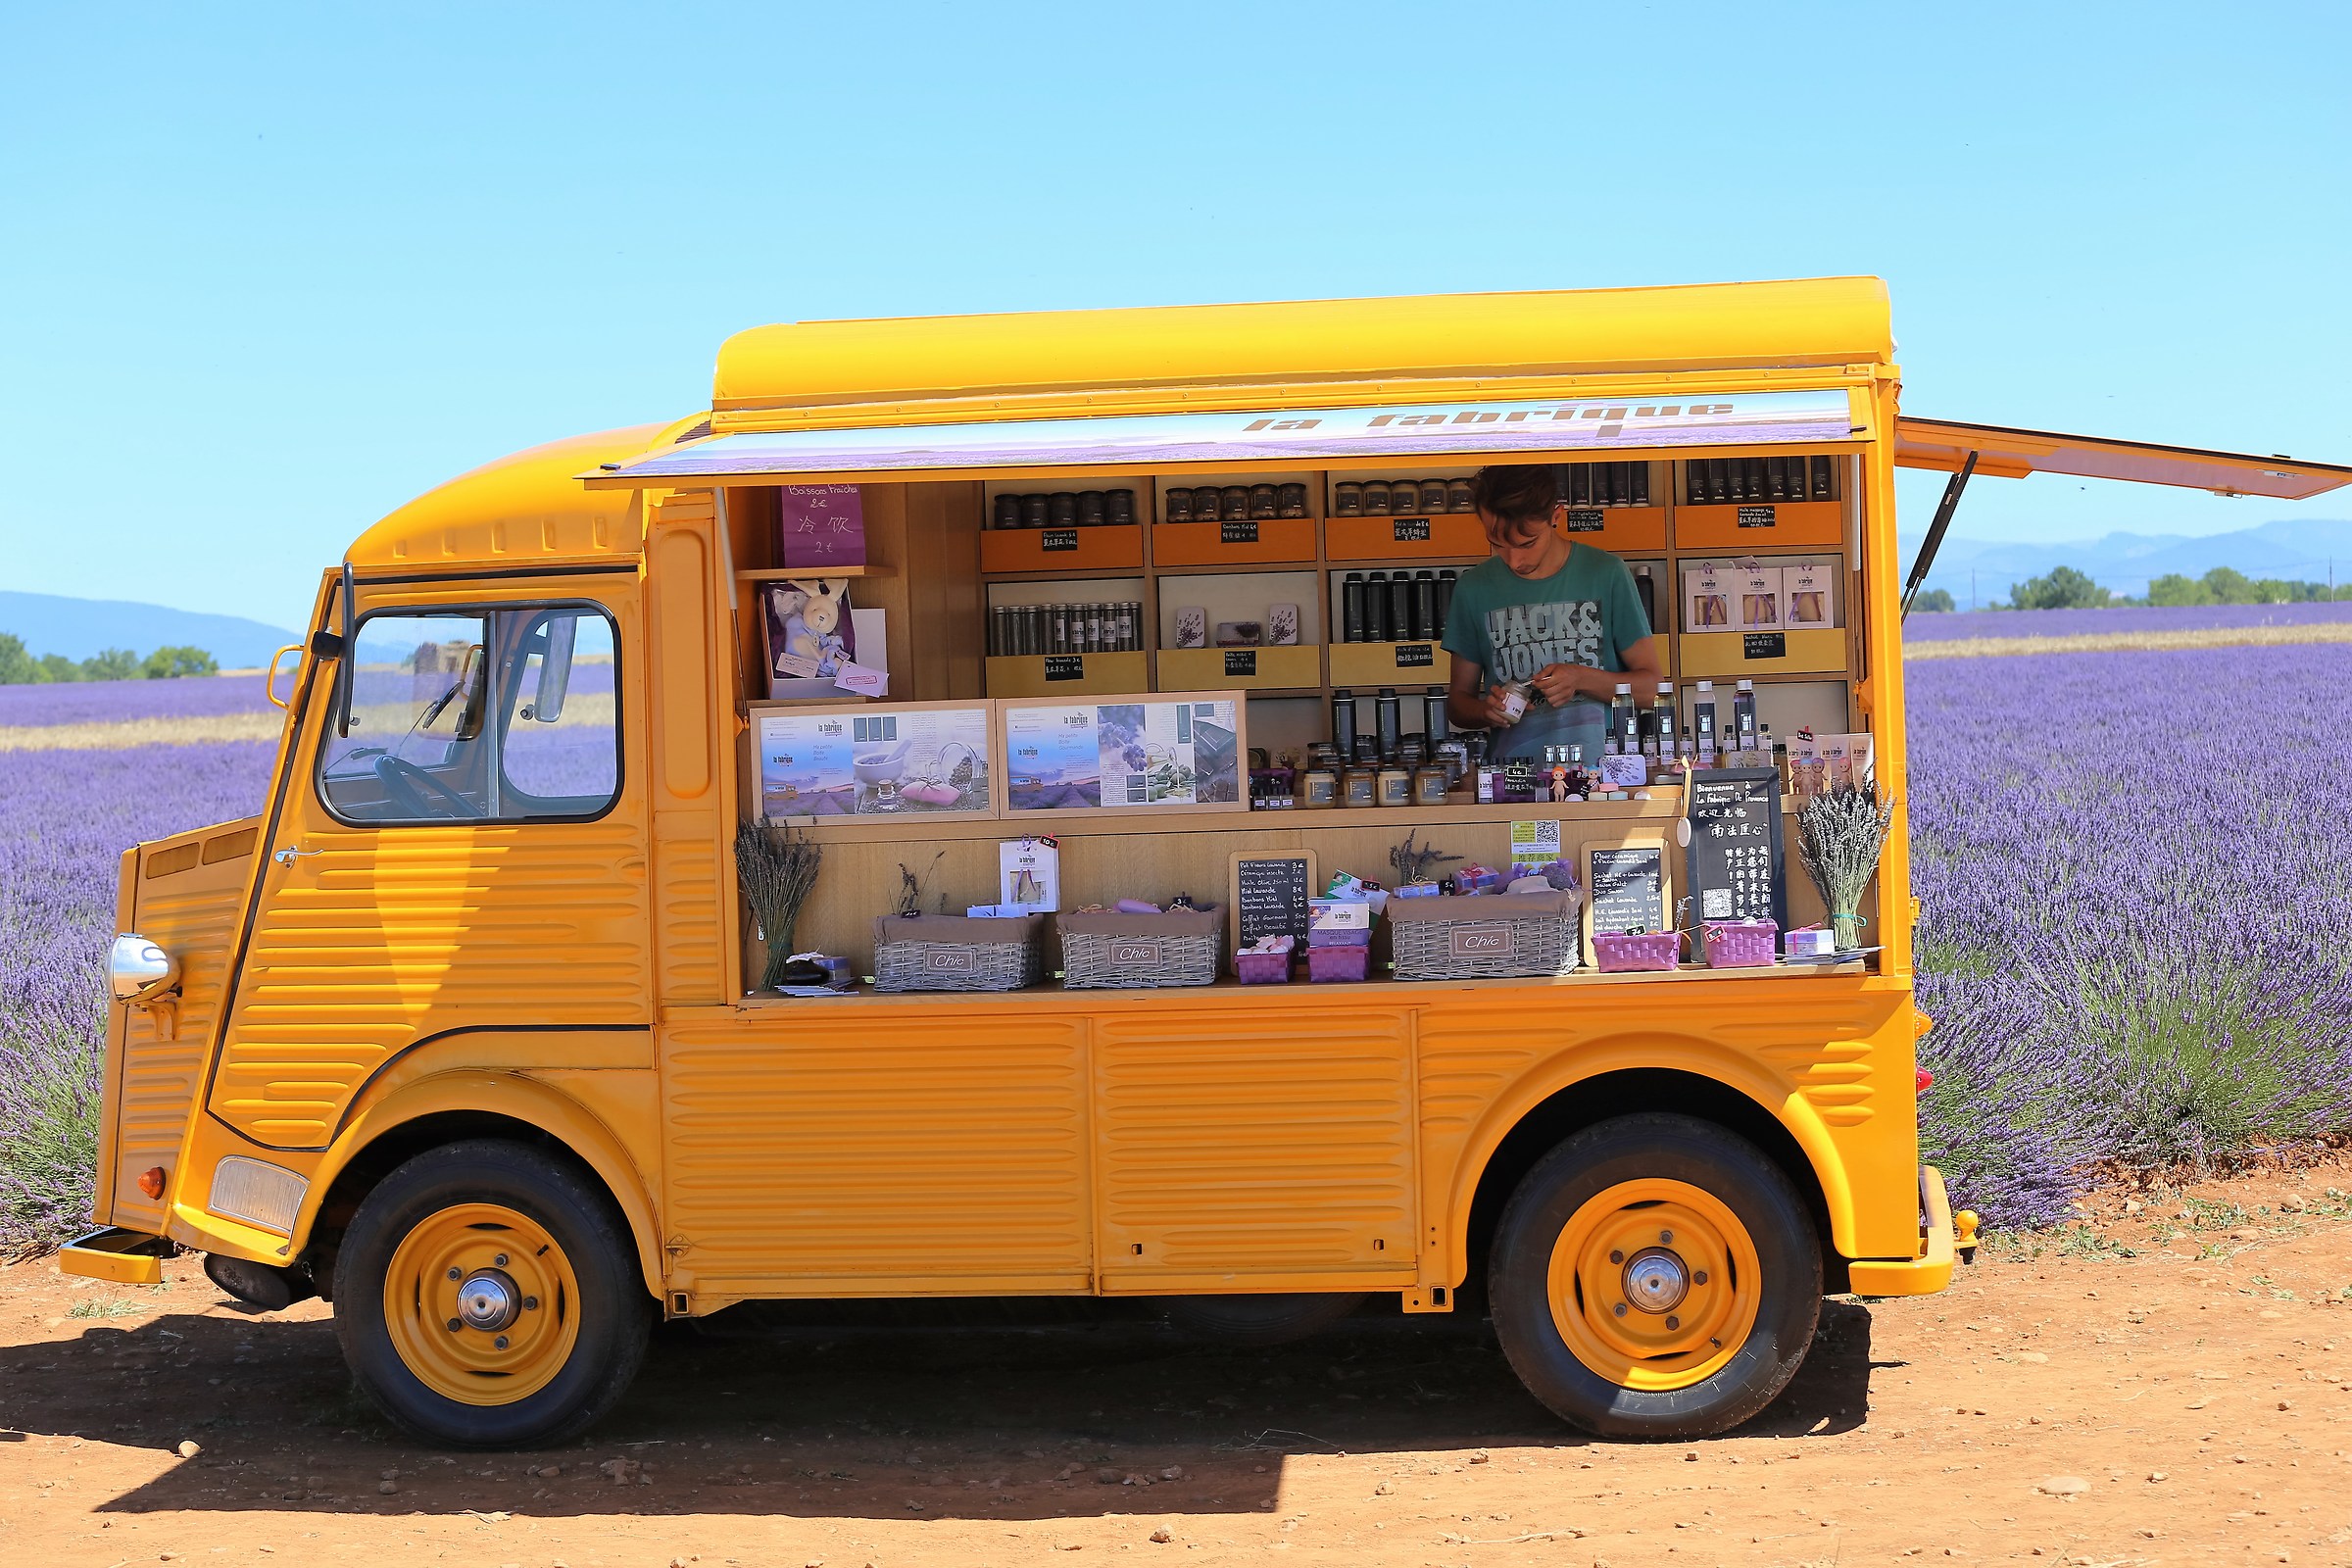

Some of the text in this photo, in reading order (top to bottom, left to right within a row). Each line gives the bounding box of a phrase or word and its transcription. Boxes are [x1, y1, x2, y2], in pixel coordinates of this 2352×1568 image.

[1243, 404, 1735, 438] la fabrique
[789, 484, 827, 496] Boissons
[1488, 601, 1601, 648] JACK&
[1697, 781, 1752, 793] Bienvenue à
[1696, 794, 1705, 804] La
[1735, 792, 1742, 802] De
[1698, 808, 1747, 818] 欢迎光临
[1465, 935, 1499, 949] Chic
[1119, 947, 1151, 960] Chic
[935, 955, 964, 967] Chic
